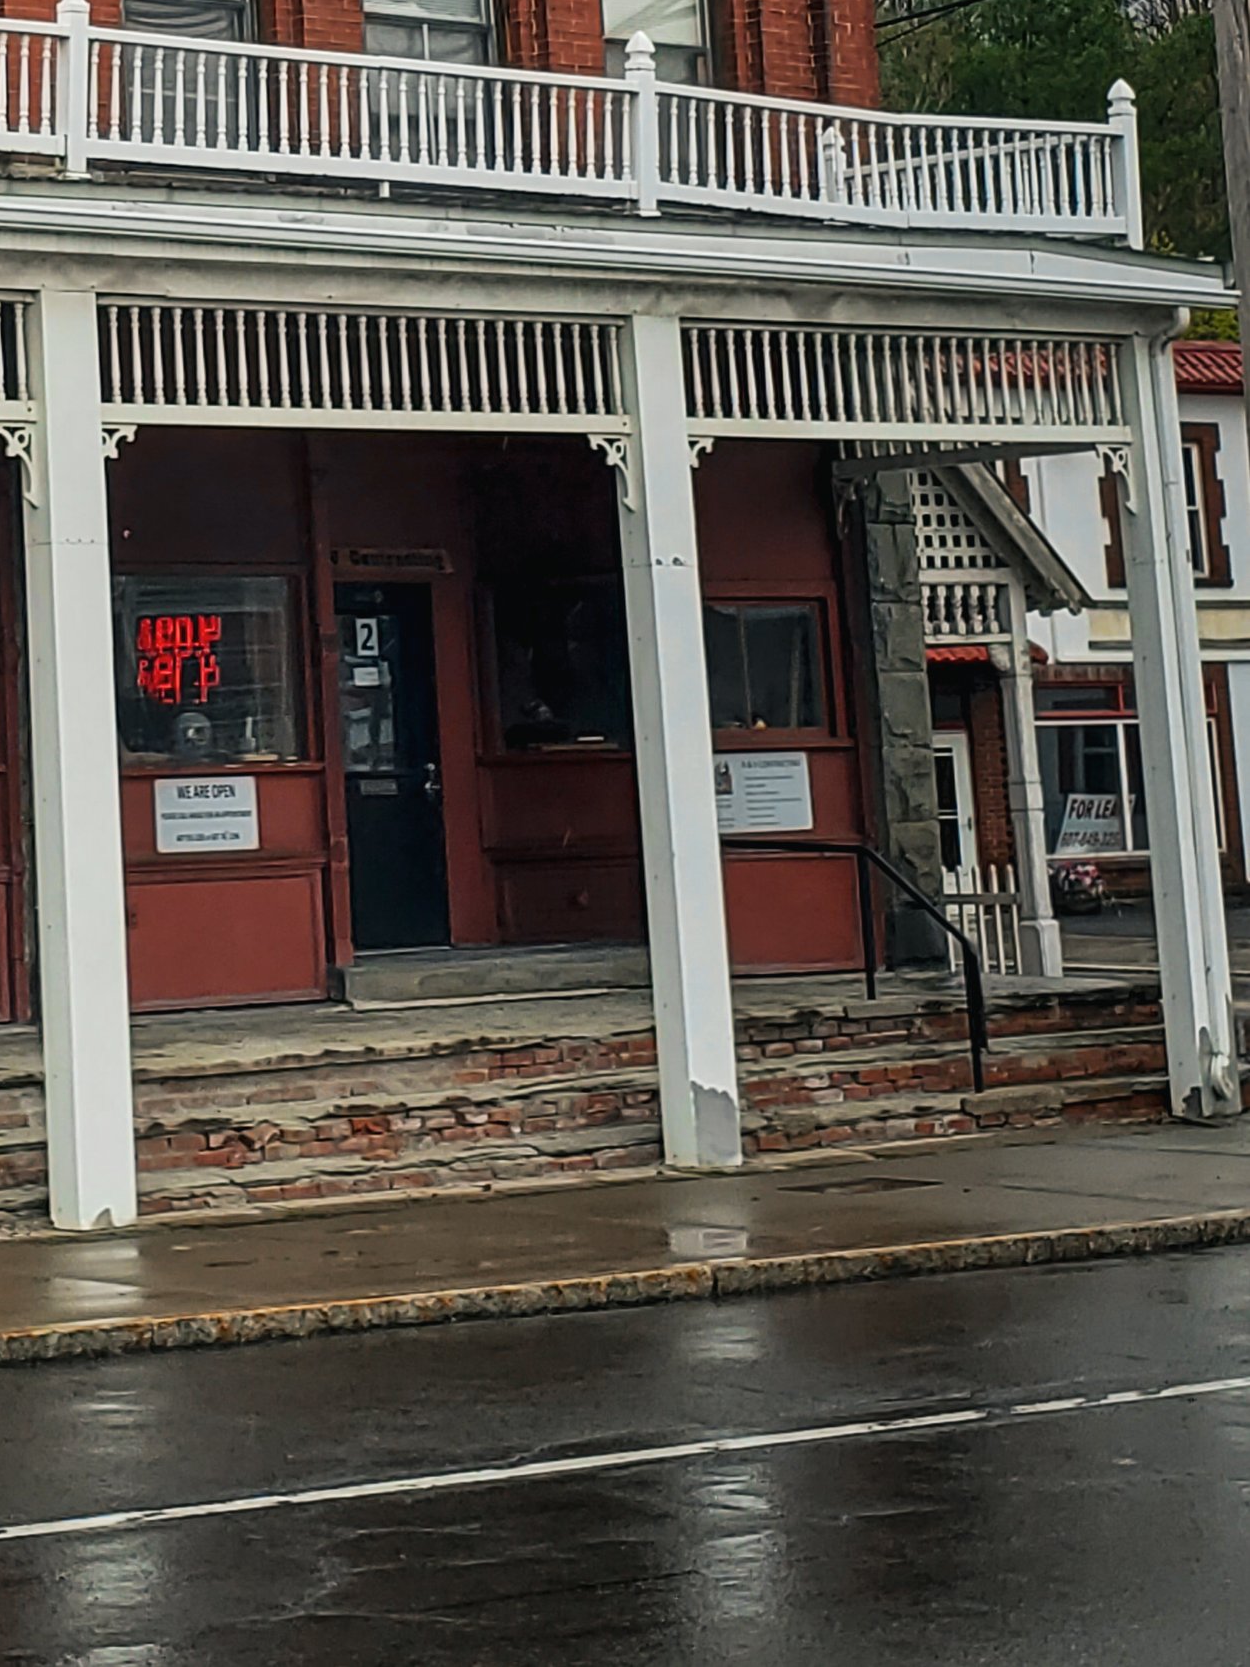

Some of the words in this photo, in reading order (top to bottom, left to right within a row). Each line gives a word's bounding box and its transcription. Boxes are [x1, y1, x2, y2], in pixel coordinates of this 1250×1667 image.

[360, 623, 374, 651] 2
[176, 785, 191, 799] WE
[193, 785, 210, 799] ARE
[212, 784, 236, 799] OPEN
[1068, 798, 1095, 820] FOR
